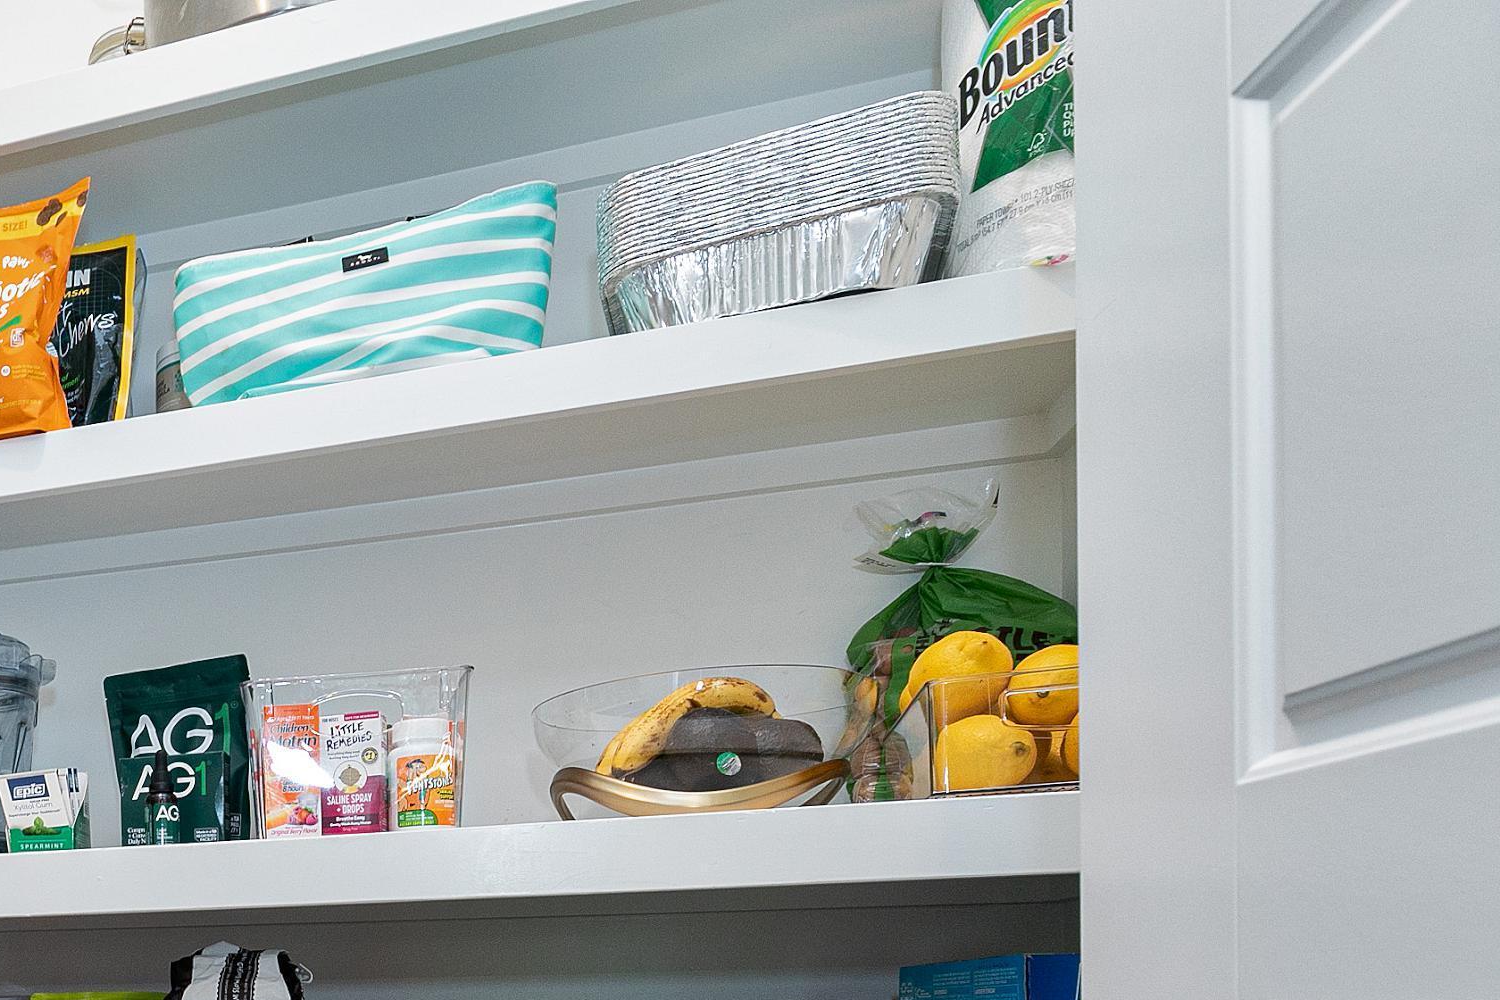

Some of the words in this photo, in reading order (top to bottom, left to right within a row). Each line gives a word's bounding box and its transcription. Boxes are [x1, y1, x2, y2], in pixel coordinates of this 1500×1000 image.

[2, 220, 29, 232] SIZE!
[2, 254, 30, 270] Paws
[59, 311, 116, 357] Chews
[330, 721, 365, 738] LITTLE
[326, 732, 372, 750] REMEDIES
[351, 793, 372, 803] SPRAY
